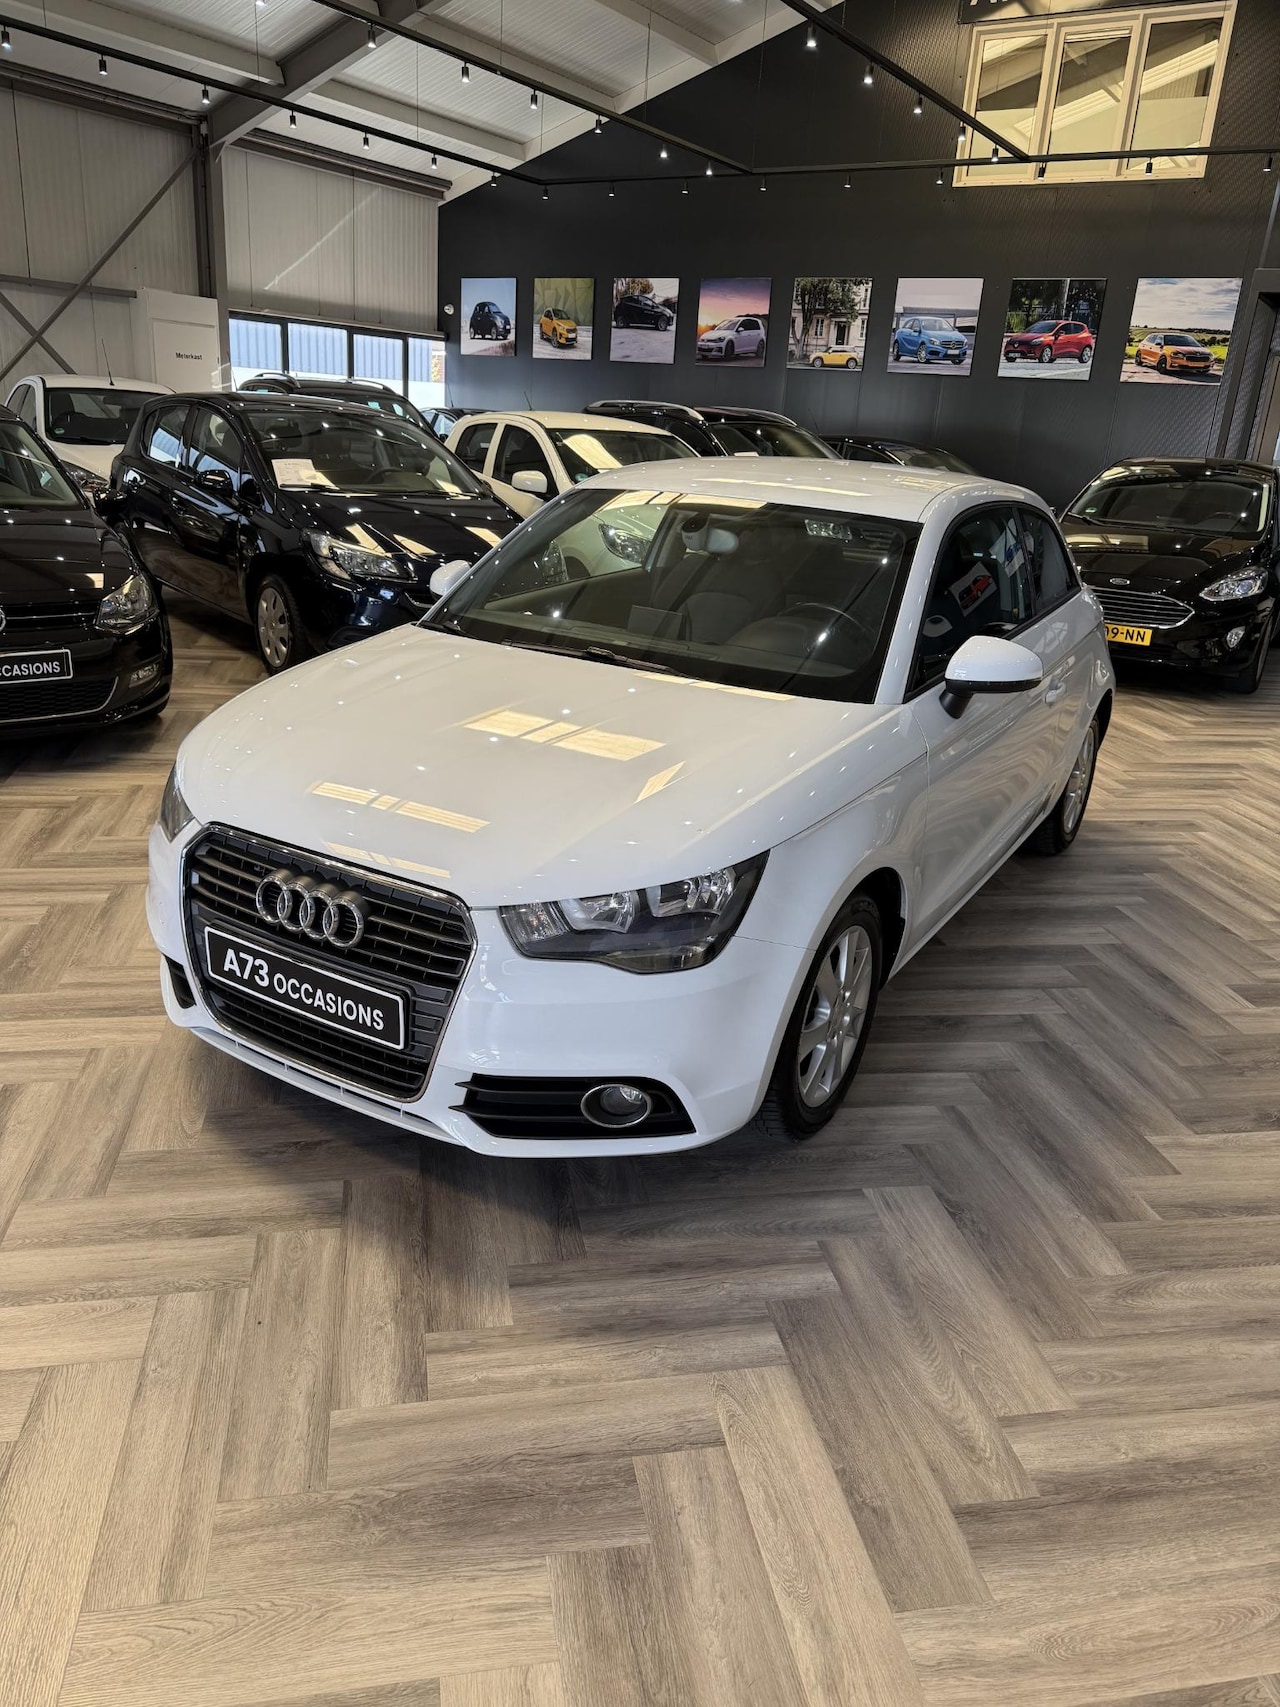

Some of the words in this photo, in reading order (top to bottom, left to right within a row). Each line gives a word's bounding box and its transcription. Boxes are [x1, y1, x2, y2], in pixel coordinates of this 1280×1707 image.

[175, 352, 203, 360] Meterkast
[0, 661, 61, 677] CASIONS
[223, 948, 270, 988] A73
[273, 974, 385, 1031] OCCASIONS
